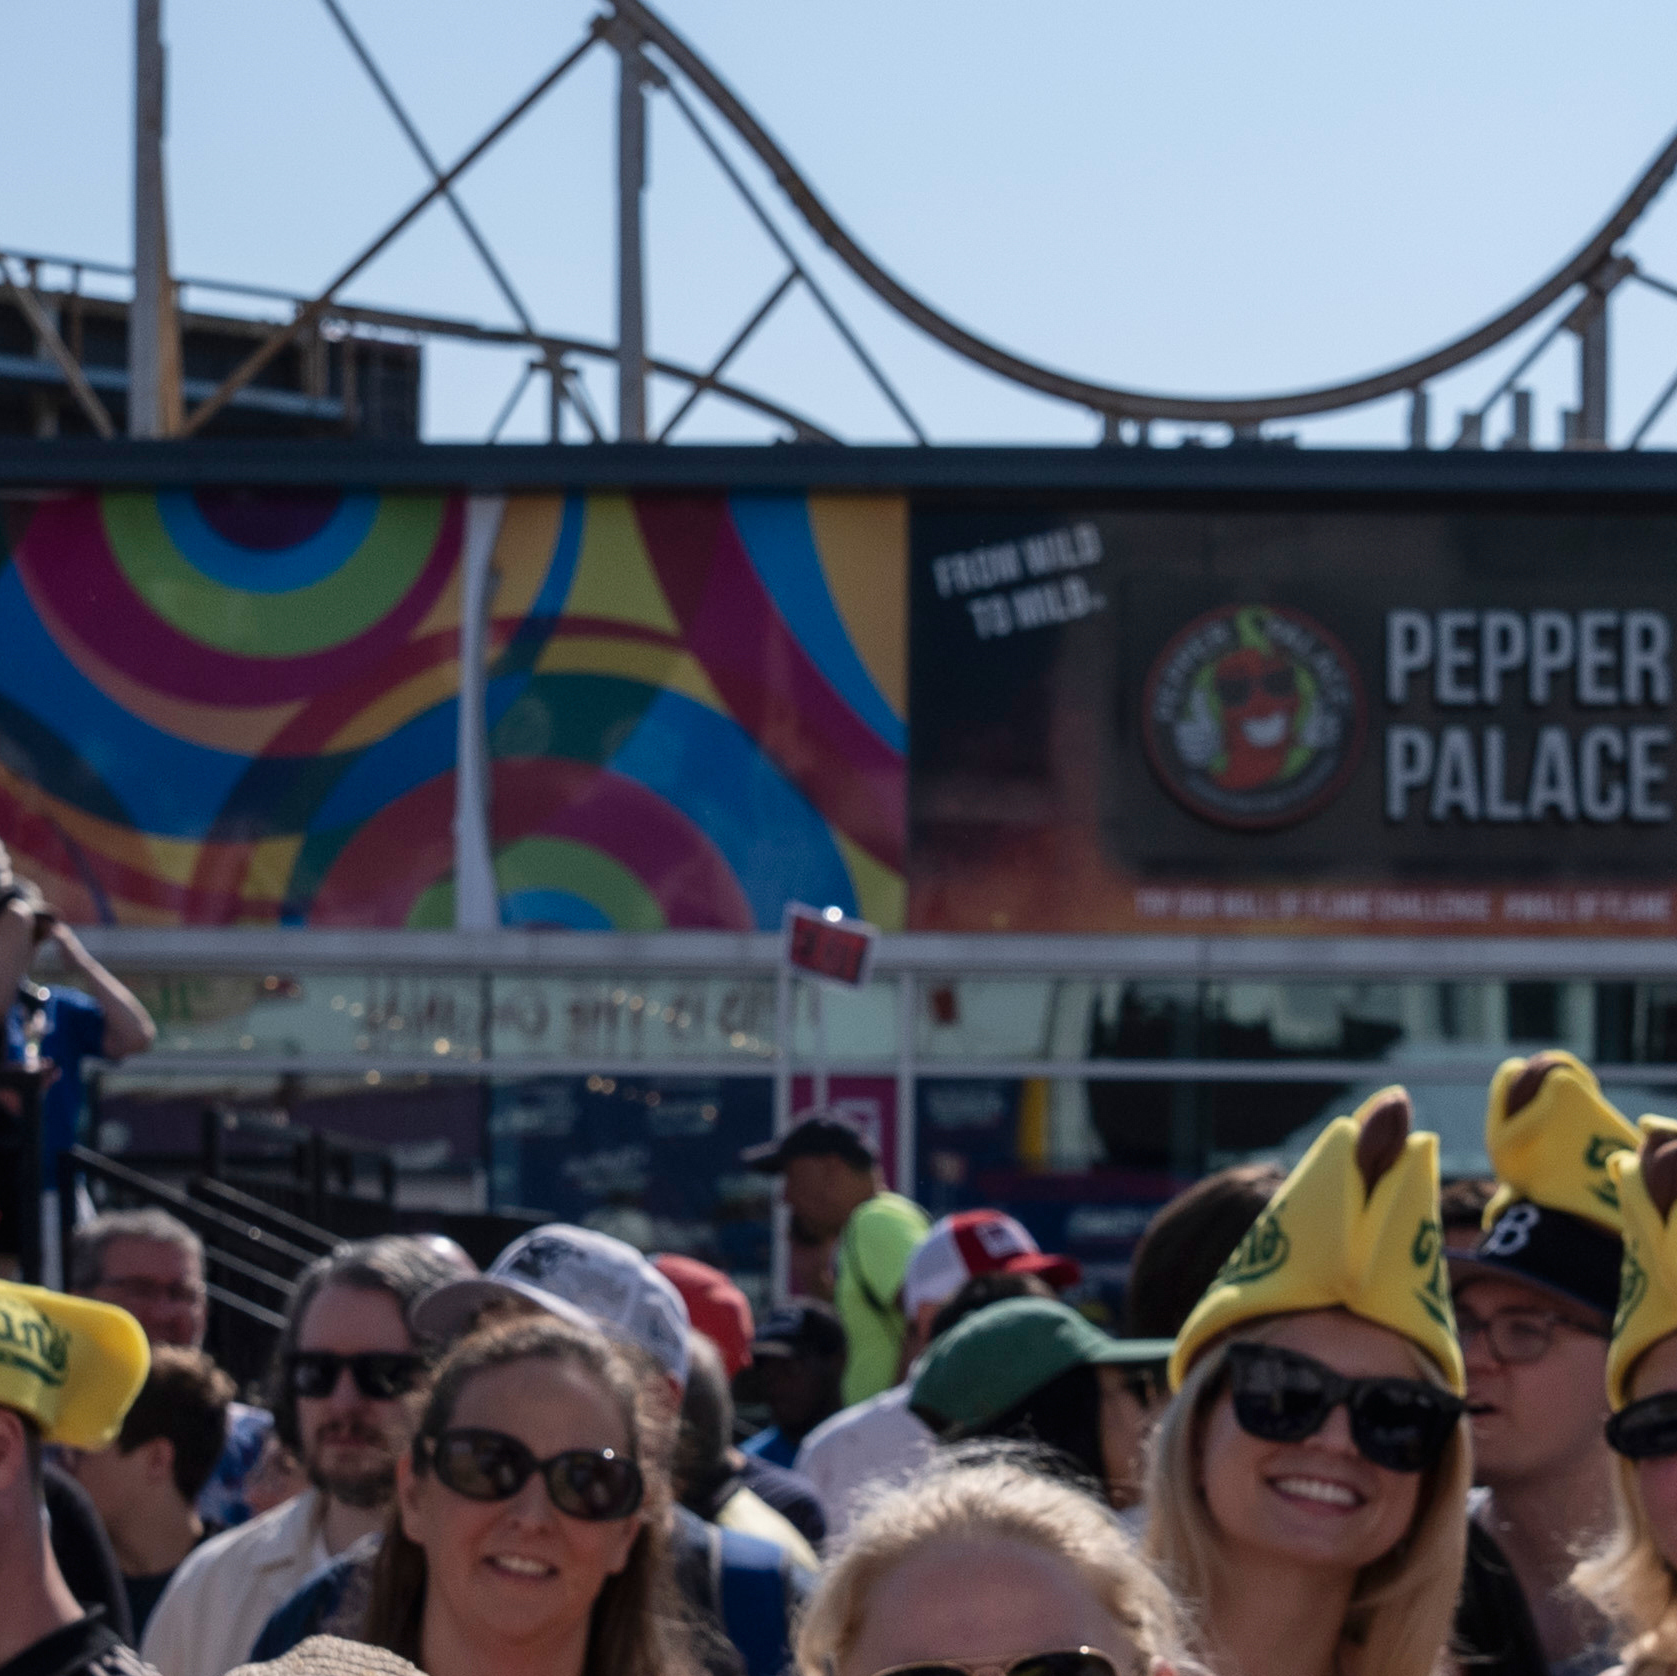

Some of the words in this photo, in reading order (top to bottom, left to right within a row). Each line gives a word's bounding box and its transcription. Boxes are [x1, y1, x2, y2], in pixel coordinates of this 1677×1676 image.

[931, 538, 1024, 600] FROM
[966, 593, 1012, 640] TO
[1385, 609, 1672, 706] PEPPER
[1385, 727, 1672, 824] PALACE
[1483, 1202, 1542, 1257] B
